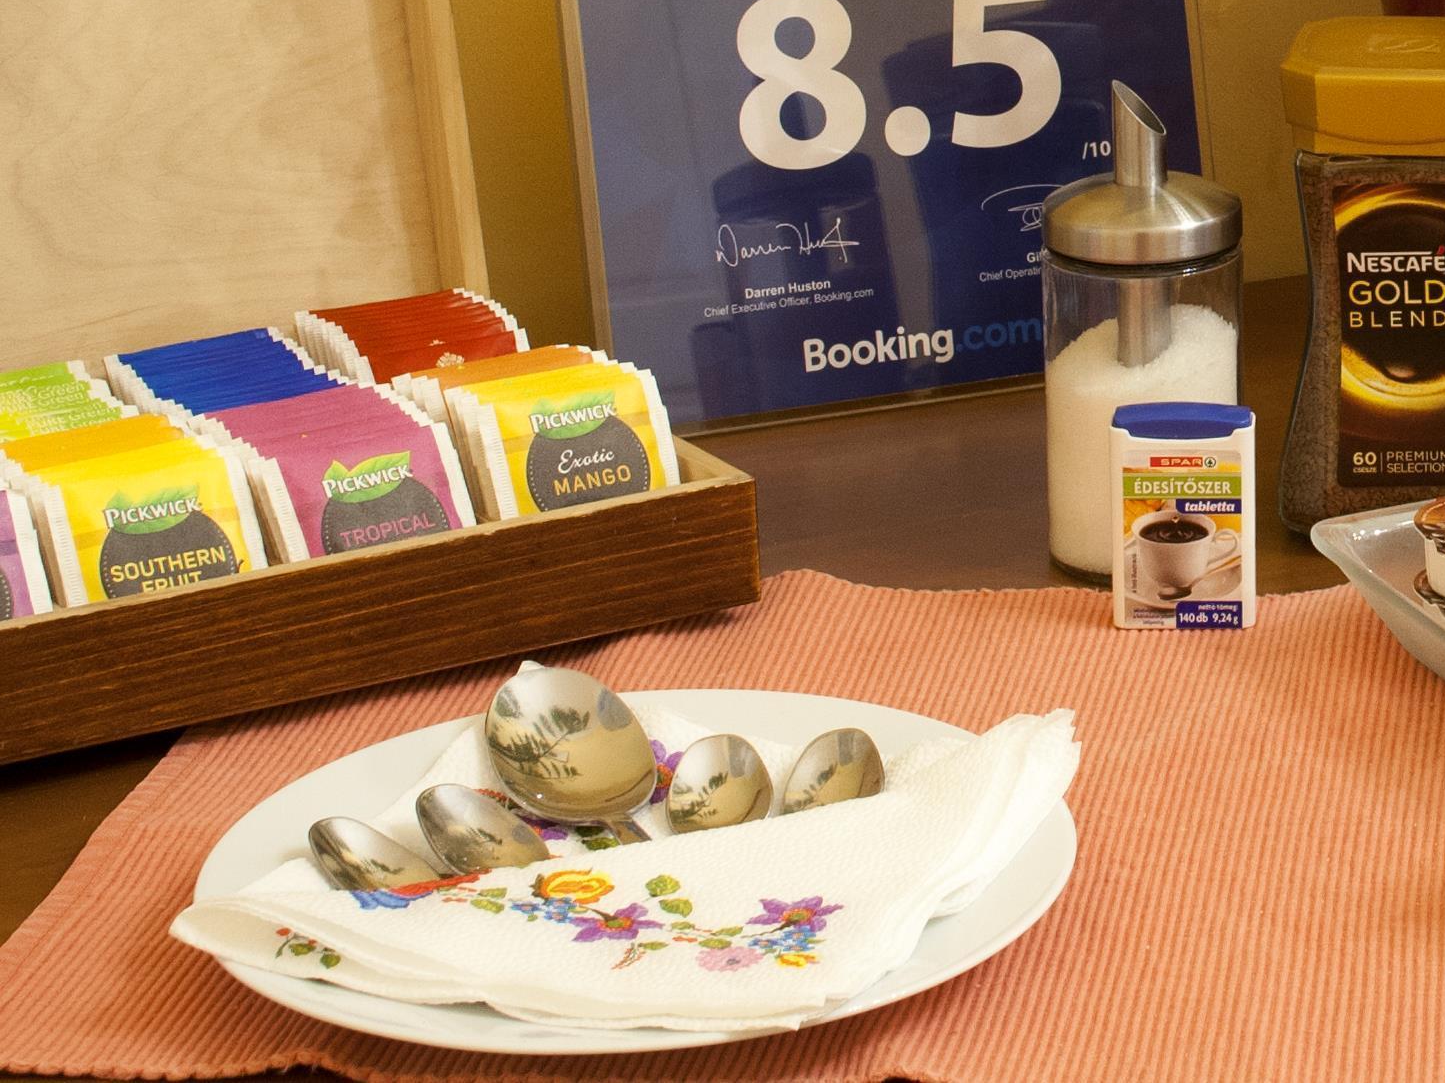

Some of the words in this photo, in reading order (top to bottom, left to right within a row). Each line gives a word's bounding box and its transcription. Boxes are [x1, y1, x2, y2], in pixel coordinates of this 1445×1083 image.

[1082, 140, 1112, 160] /10
[704, 304, 730, 318] Chief
[731, 301, 777, 315] Executive
[813, 288, 875, 303] Booking.com
[744, 286, 786, 300] Darren
[787, 279, 832, 294] Huston
[803, 317, 1043, 373] Booking.com
[529, 403, 618, 434] PICKWICK
[557, 448, 615, 474] Exotic
[1160, 458, 1202, 466] SPAR
[1352, 451, 1377, 465] 60
[322, 464, 414, 498] PICKWICK
[553, 464, 632, 496] MANGO
[1134, 478, 1232, 495] ÉDESÍTŐSZER
[103, 497, 202, 529] PICKWICK
[1184, 501, 1236, 512] tabletta
[340, 512, 436, 547] TROPICAL
[110, 546, 227, 583] SOUTHERN
[1178, 613, 1195, 623] 140
[1196, 613, 1208, 623] db
[1212, 613, 1232, 624] 9,24
[1233, 615, 1239, 626] g
